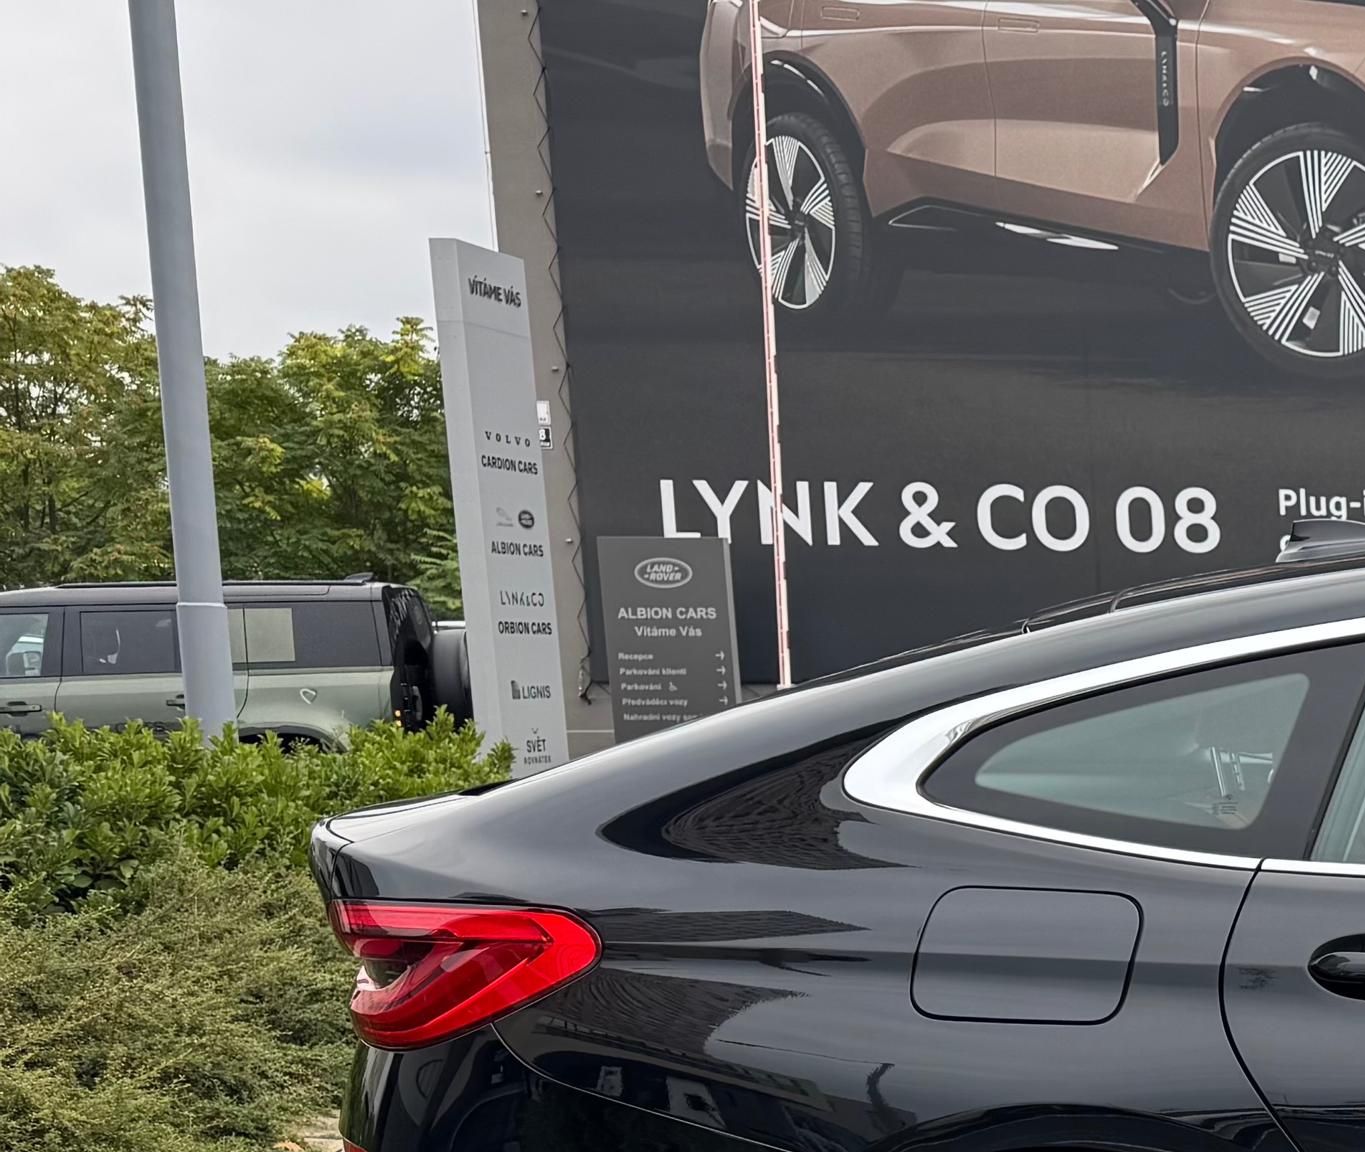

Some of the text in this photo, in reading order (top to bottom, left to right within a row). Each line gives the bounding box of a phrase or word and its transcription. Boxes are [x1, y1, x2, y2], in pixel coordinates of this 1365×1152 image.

[503, 285, 522, 308] VÁS
[485, 431, 531, 447] VOLVO
[481, 454, 538, 475] CARDION CARS
[660, 479, 1222, 553] LYNK & CO 08
[491, 541, 544, 557] ALBION CARS
[646, 564, 673, 573] LAND
[649, 572, 682, 581] ROVER
[500, 590, 545, 607] LYNK&CO
[618, 607, 717, 619] ALBION CARS
[498, 621, 552, 635] ORBION CARS
[679, 626, 702, 637] Vás
[522, 685, 551, 699] LIGNIS
